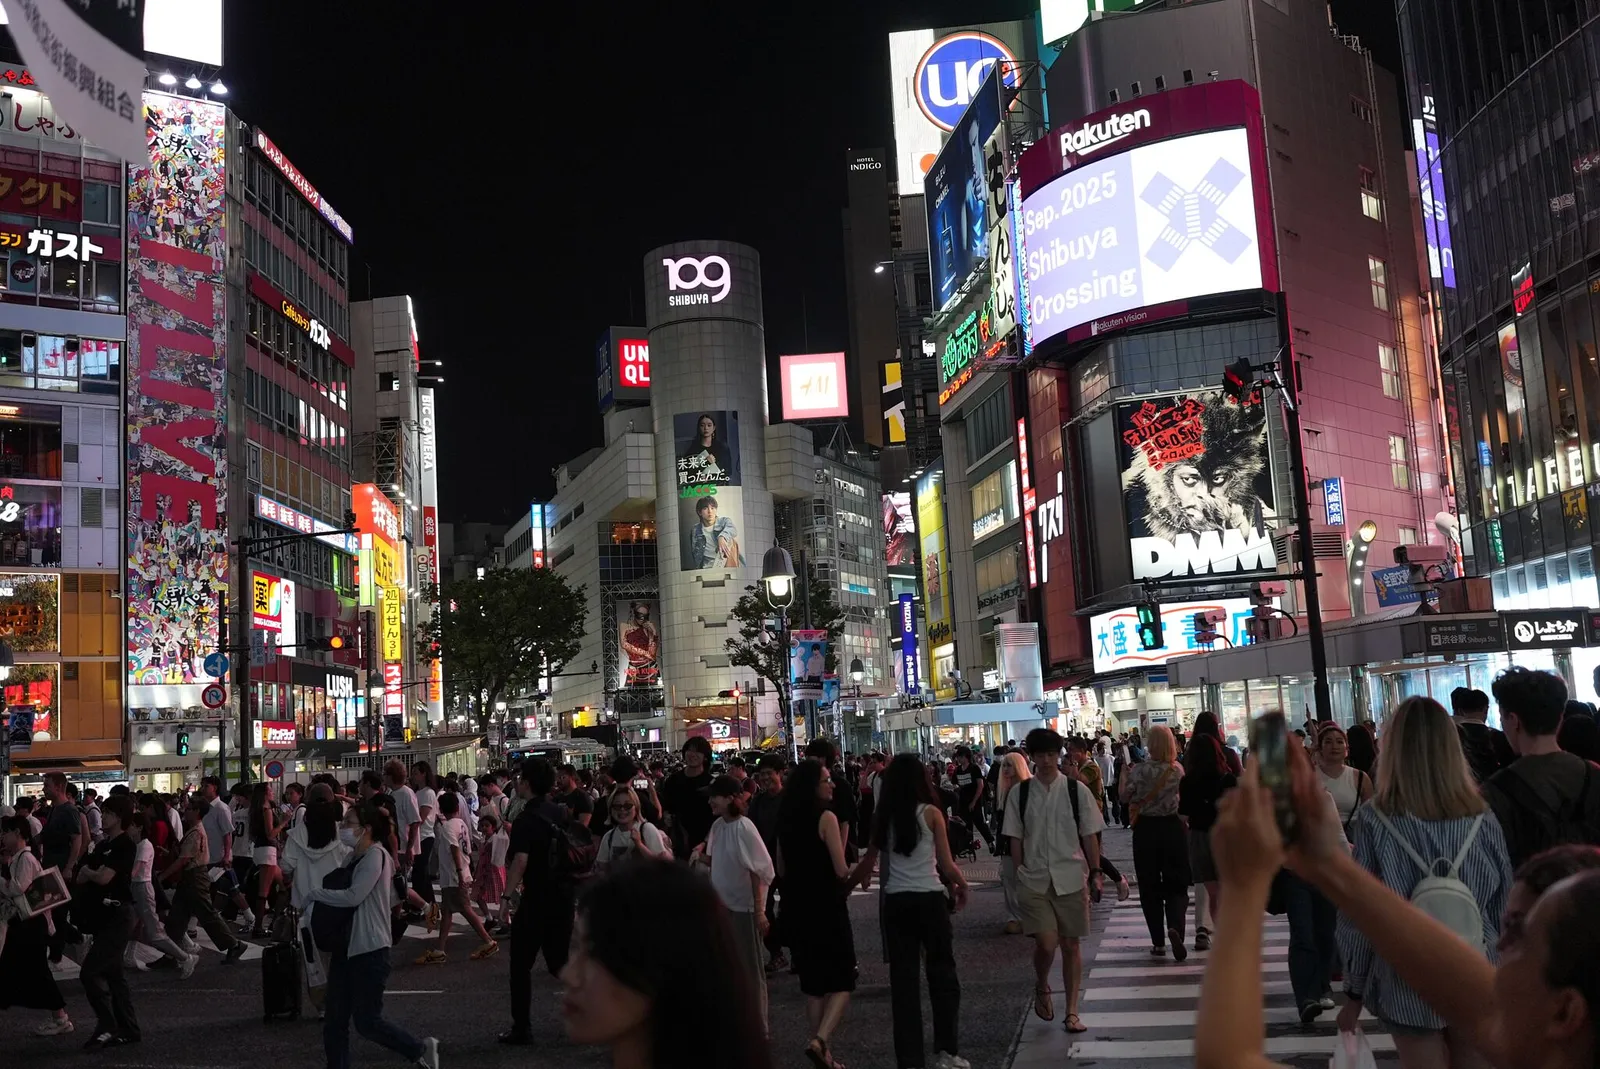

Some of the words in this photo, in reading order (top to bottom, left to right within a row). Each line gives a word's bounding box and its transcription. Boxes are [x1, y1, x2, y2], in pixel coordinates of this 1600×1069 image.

[1060, 108, 1150, 156] Rakuten
[850, 162, 882, 171] INDIGO
[935, 185, 950, 210] CHANEL
[26, 229, 104, 262] ガスト
[1028, 226, 1118, 281] Shibuya
[662, 255, 731, 303] 109
[669, 294, 709, 306] SHIBUYA
[1033, 268, 1138, 325] Crossing
[1096, 317, 1122, 331] Rakuten
[1123, 311, 1148, 326] Vision
[309, 319, 331, 351] ガスト
[421, 394, 432, 416] BIC
[422, 419, 435, 473] CAMERA
[678, 469, 731, 484] 買ったんだ。
[679, 484, 718, 498] JACCS
[424, 516, 435, 536] 免税
[347, 535, 359, 553] 4F
[255, 579, 268, 612] 薬
[385, 589, 400, 638] 処方せん
[903, 601, 912, 633] MIZUHO
[388, 640, 397, 658] 3F
[1441, 634, 1467, 645] 渋谷駅
[1467, 635, 1487, 644] Shibuya
